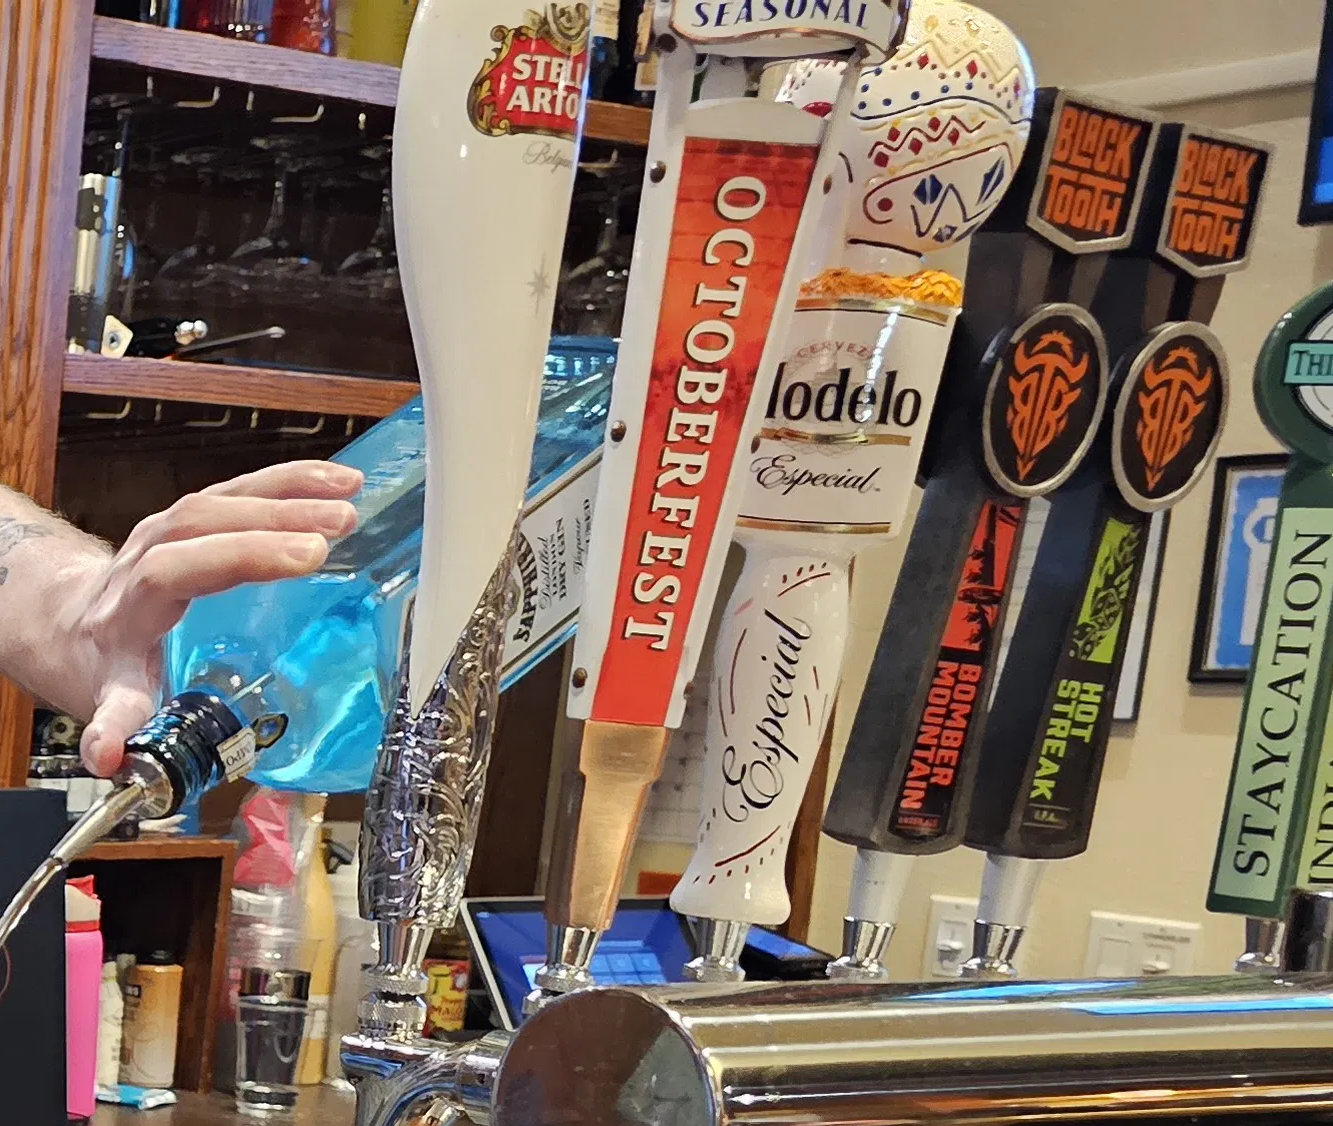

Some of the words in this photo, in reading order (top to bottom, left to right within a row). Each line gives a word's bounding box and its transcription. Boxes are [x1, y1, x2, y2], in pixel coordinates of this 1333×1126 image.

[691, 0, 869, 30] SEASONAL
[1052, 105, 1142, 178] BLACK
[1176, 138, 1258, 205] BLACK
[1044, 164, 1127, 236] TOOTH
[1168, 195, 1245, 260] TOOTH
[623, 175, 767, 651] OCTOBERFEST
[750, 454, 881, 496] Especial
[721, 608, 813, 825] Especial
[900, 659, 959, 811] MOUNTAIN
[929, 662, 982, 789] BOMBER
[1069, 682, 1104, 743] HOT
[1234, 529, 1331, 877] STAYCATION
[1030, 679, 1079, 801] STREAK
